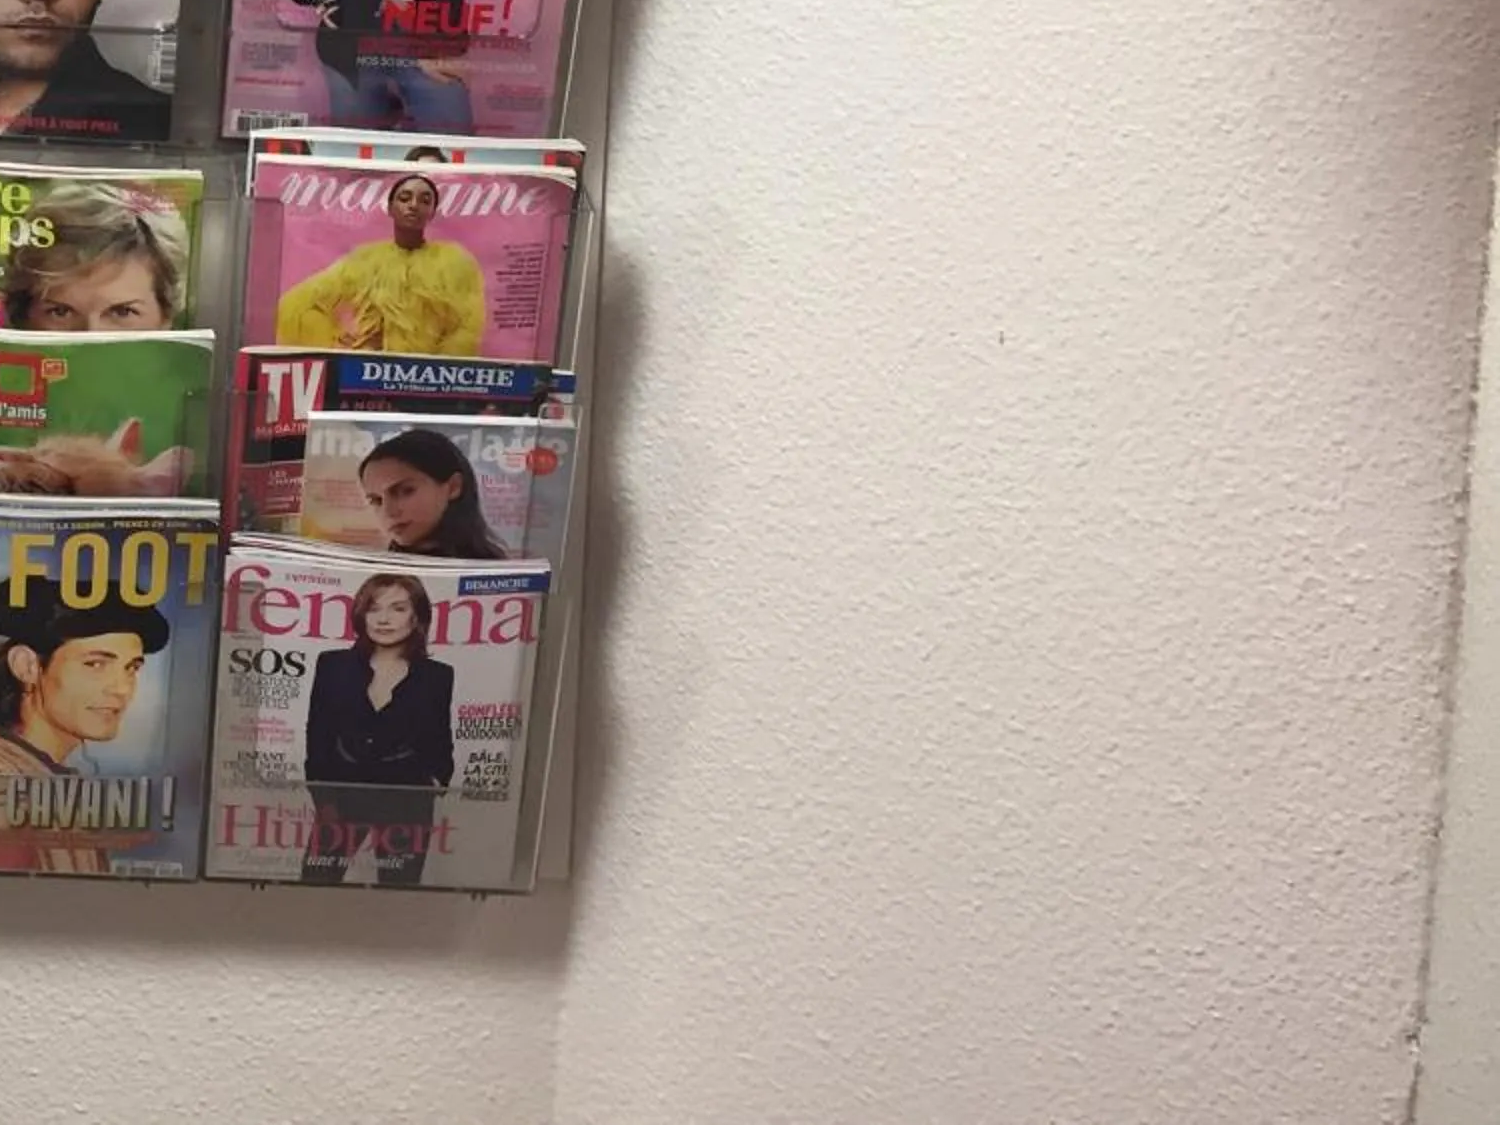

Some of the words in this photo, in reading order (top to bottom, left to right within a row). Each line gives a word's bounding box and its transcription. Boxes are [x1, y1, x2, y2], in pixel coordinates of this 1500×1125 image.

[261, 360, 326, 424] TV
[361, 362, 516, 389] DIMANCHE
[8, 530, 220, 610] FOOT
[464, 577, 530, 591] DIMANCHE
[221, 564, 538, 646] femna
[228, 648, 306, 678] SOS
[6, 775, 152, 829] CAVANI
